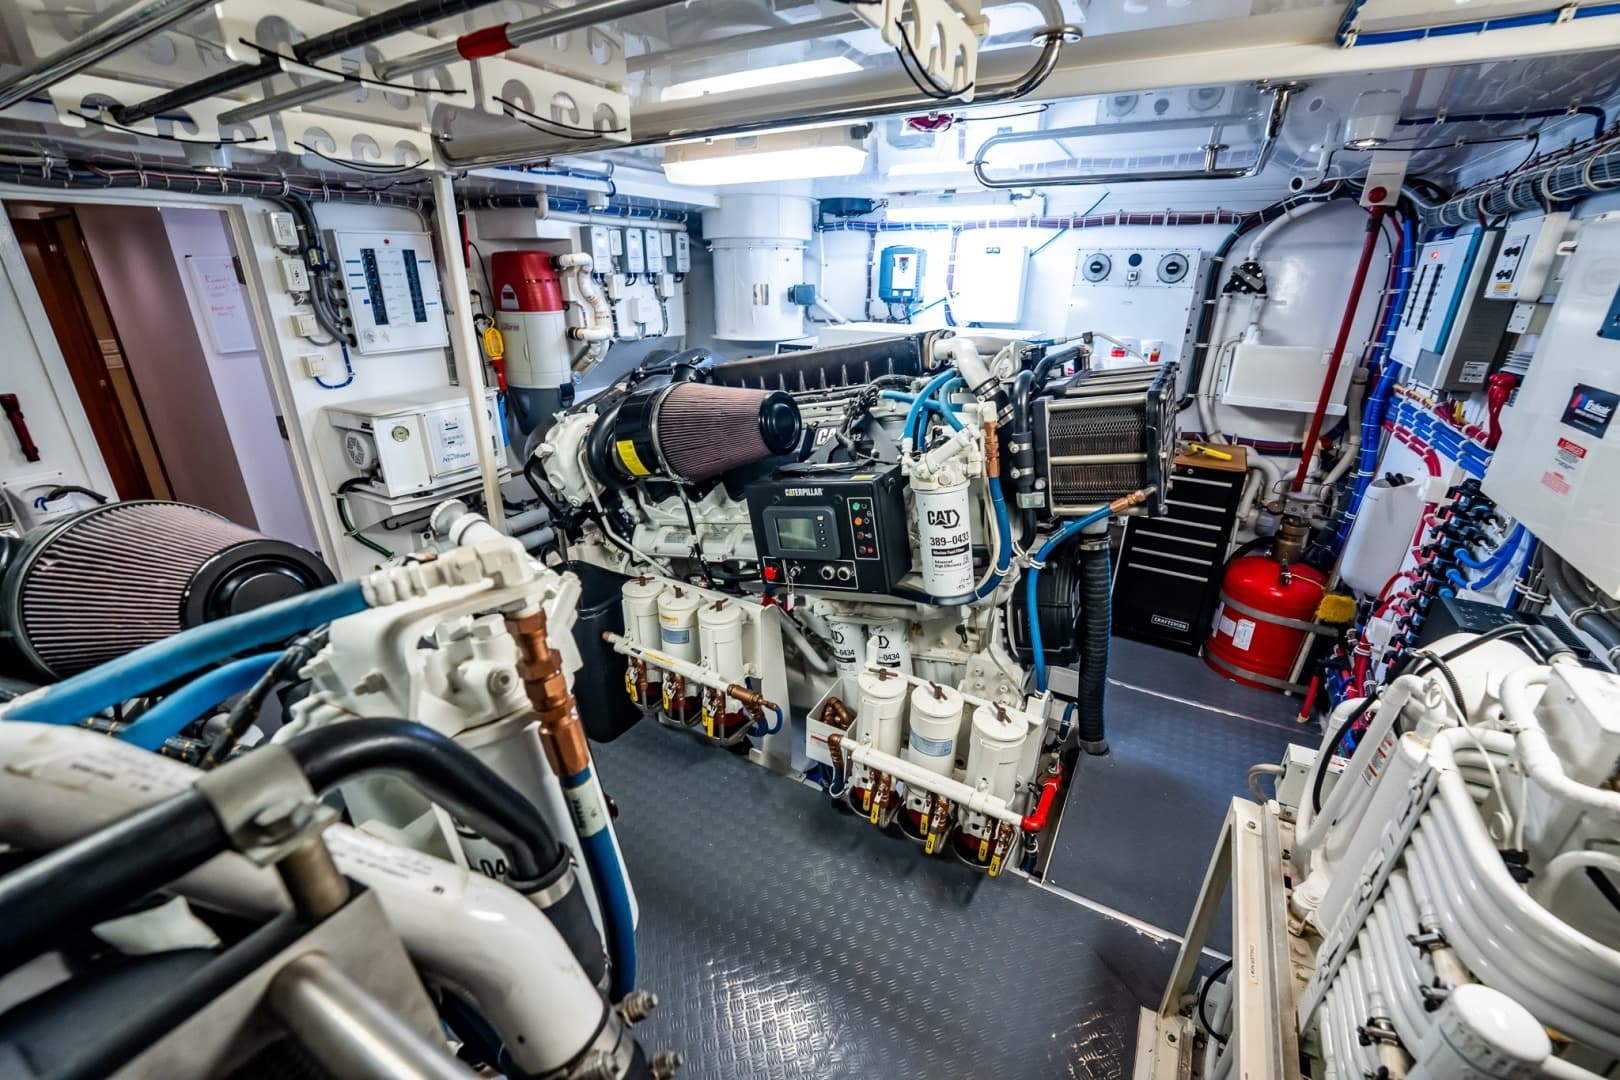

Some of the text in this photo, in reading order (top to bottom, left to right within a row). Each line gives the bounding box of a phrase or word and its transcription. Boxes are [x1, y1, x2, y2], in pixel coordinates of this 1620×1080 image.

[784, 487, 824, 497] CATERPILLAR
[927, 509, 955, 527] CAT
[878, 653, 900, 661] -0434
